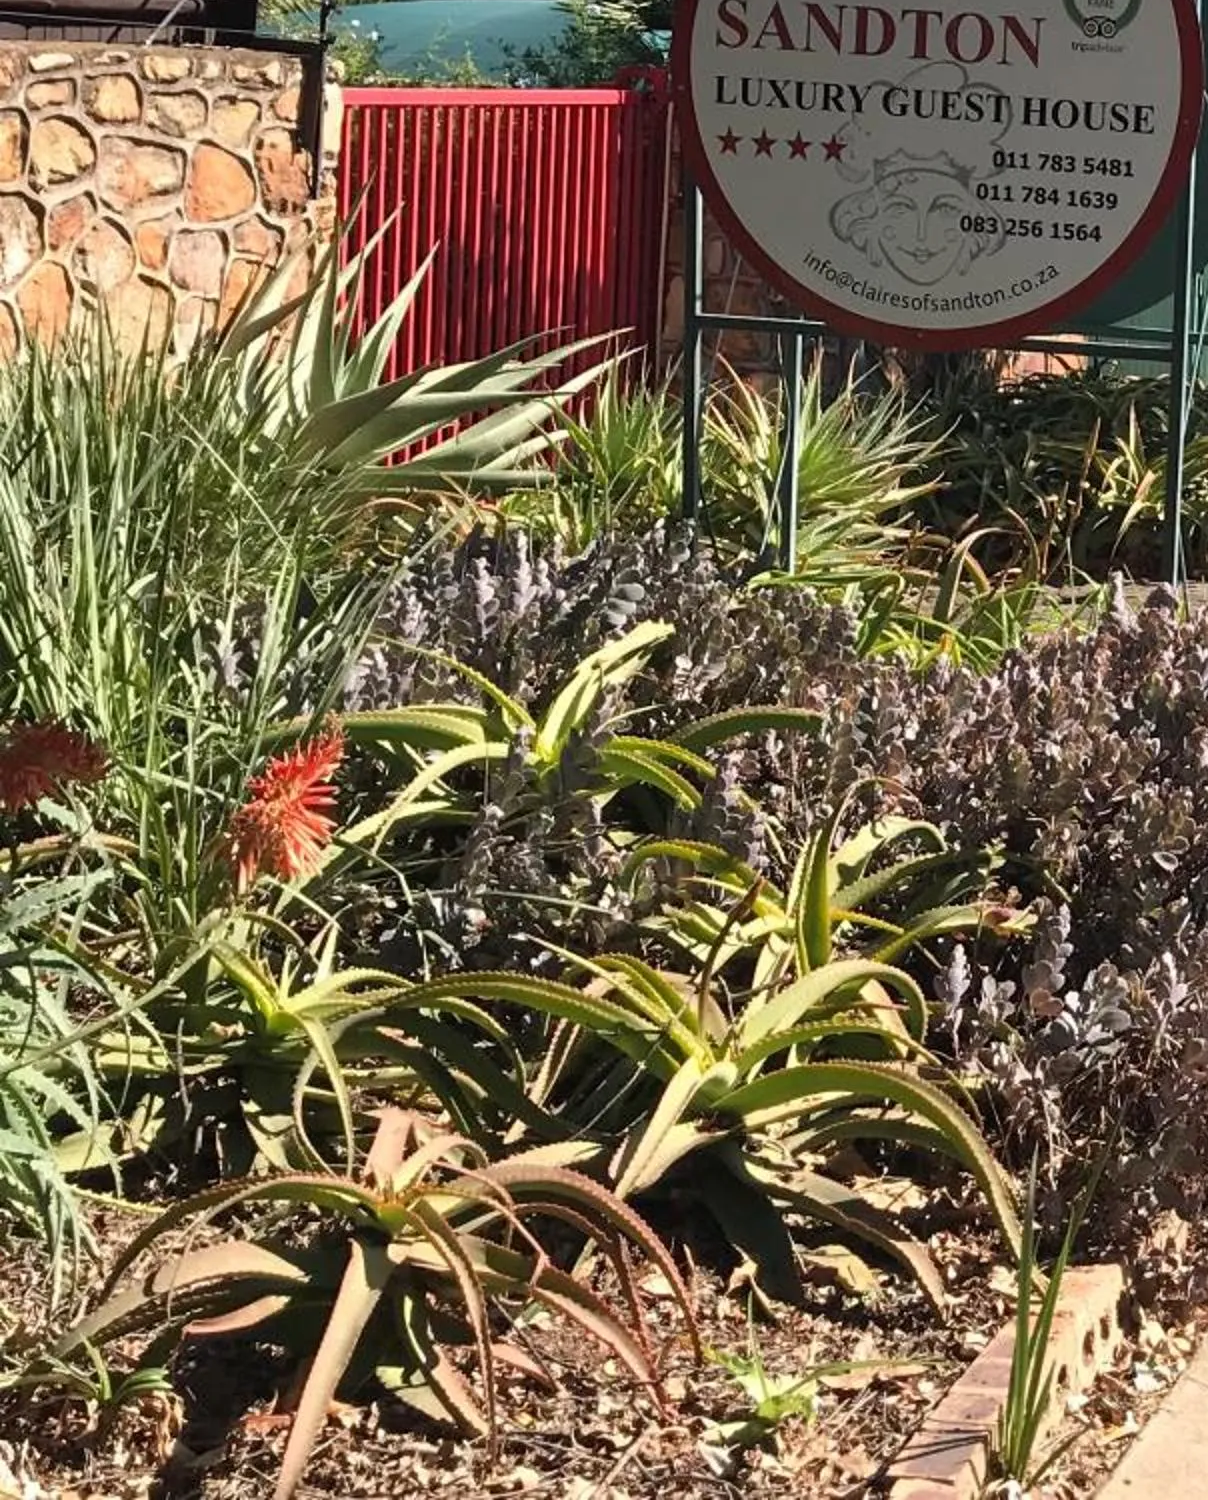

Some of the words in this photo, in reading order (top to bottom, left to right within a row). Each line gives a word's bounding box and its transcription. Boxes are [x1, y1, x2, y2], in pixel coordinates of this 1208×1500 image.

[715, 74, 873, 114] LUXURY
[882, 86, 1012, 123] GUEST
[1022, 96, 1156, 135] HOUSE
[993, 150, 1030, 170] 011
[1038, 154, 1076, 173] 783
[1083, 157, 1135, 177] 5481
[976, 183, 1014, 202] 011
[1021, 186, 1059, 205] 784
[1067, 190, 1118, 210] 1639
[960, 215, 998, 234] 083
[1005, 218, 1043, 237] 256
[1050, 222, 1102, 243] 1564
[803, 250, 1059, 312] info@clairesofsandton.co.za
